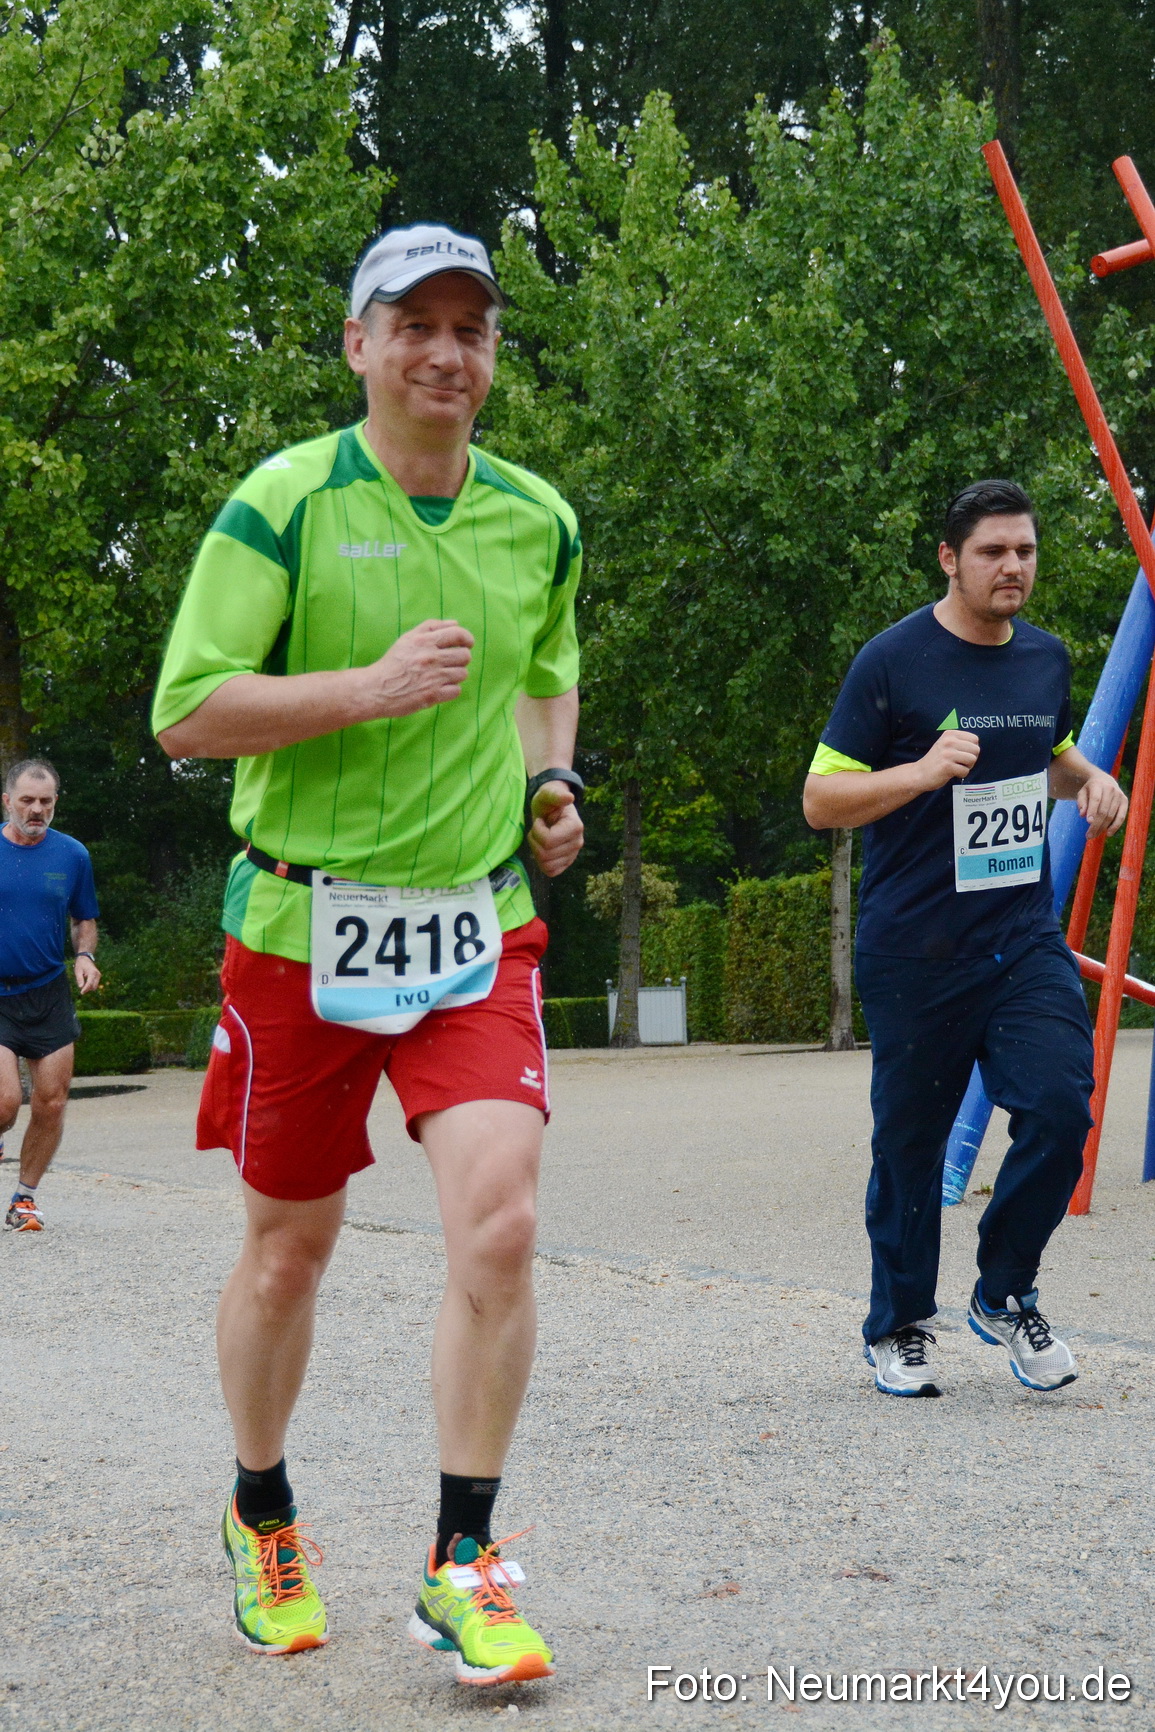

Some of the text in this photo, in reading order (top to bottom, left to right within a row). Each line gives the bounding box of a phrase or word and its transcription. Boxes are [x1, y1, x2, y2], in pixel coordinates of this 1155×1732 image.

[404, 241, 478, 261] saller
[338, 540, 408, 558] saller
[960, 716, 1004, 729] GOSSEN
[1002, 779, 1042, 797] BOCK
[962, 795, 998, 803] NeuerMarkt
[967, 800, 1043, 849] 2294
[988, 856, 1034, 873] Roman
[329, 892, 389, 903] NeuerMarkt
[335, 911, 486, 976] 2418
[321, 975, 329, 985] D
